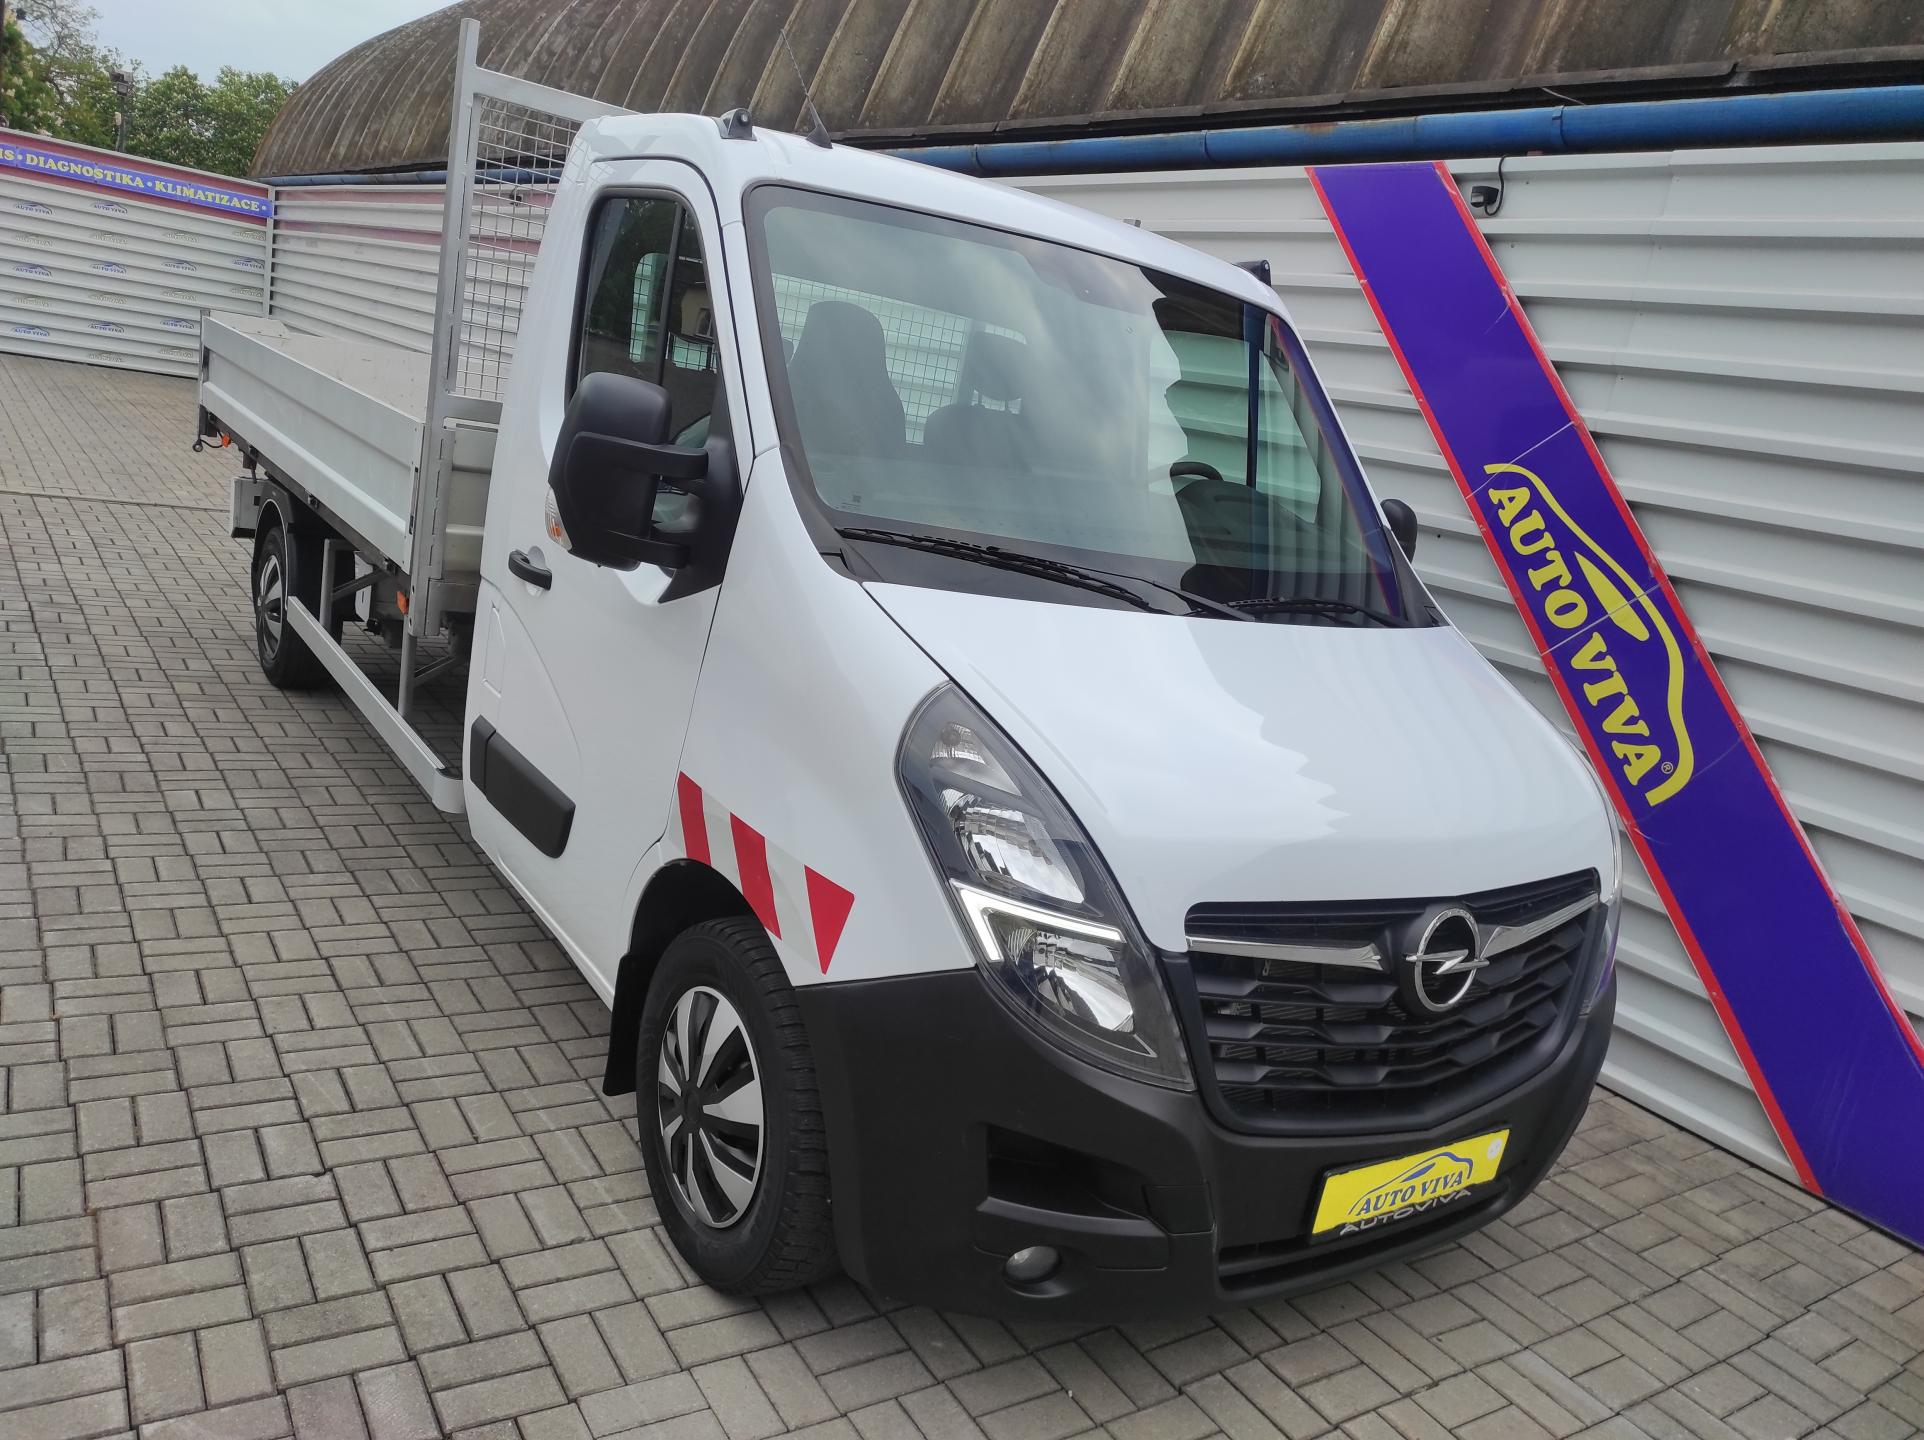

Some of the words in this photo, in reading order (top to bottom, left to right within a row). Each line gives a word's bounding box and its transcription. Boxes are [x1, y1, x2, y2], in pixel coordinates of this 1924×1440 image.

[26, 153, 144, 188] DIAGNOSTIKA
[154, 180, 260, 212] KLIMATIZACE
[1488, 486, 1588, 629] AUTO
[1339, 1188, 1471, 1236] AUTOVIVA
[1356, 1184, 1416, 1216] AUTO
[1421, 1170, 1463, 1197] VIVA
